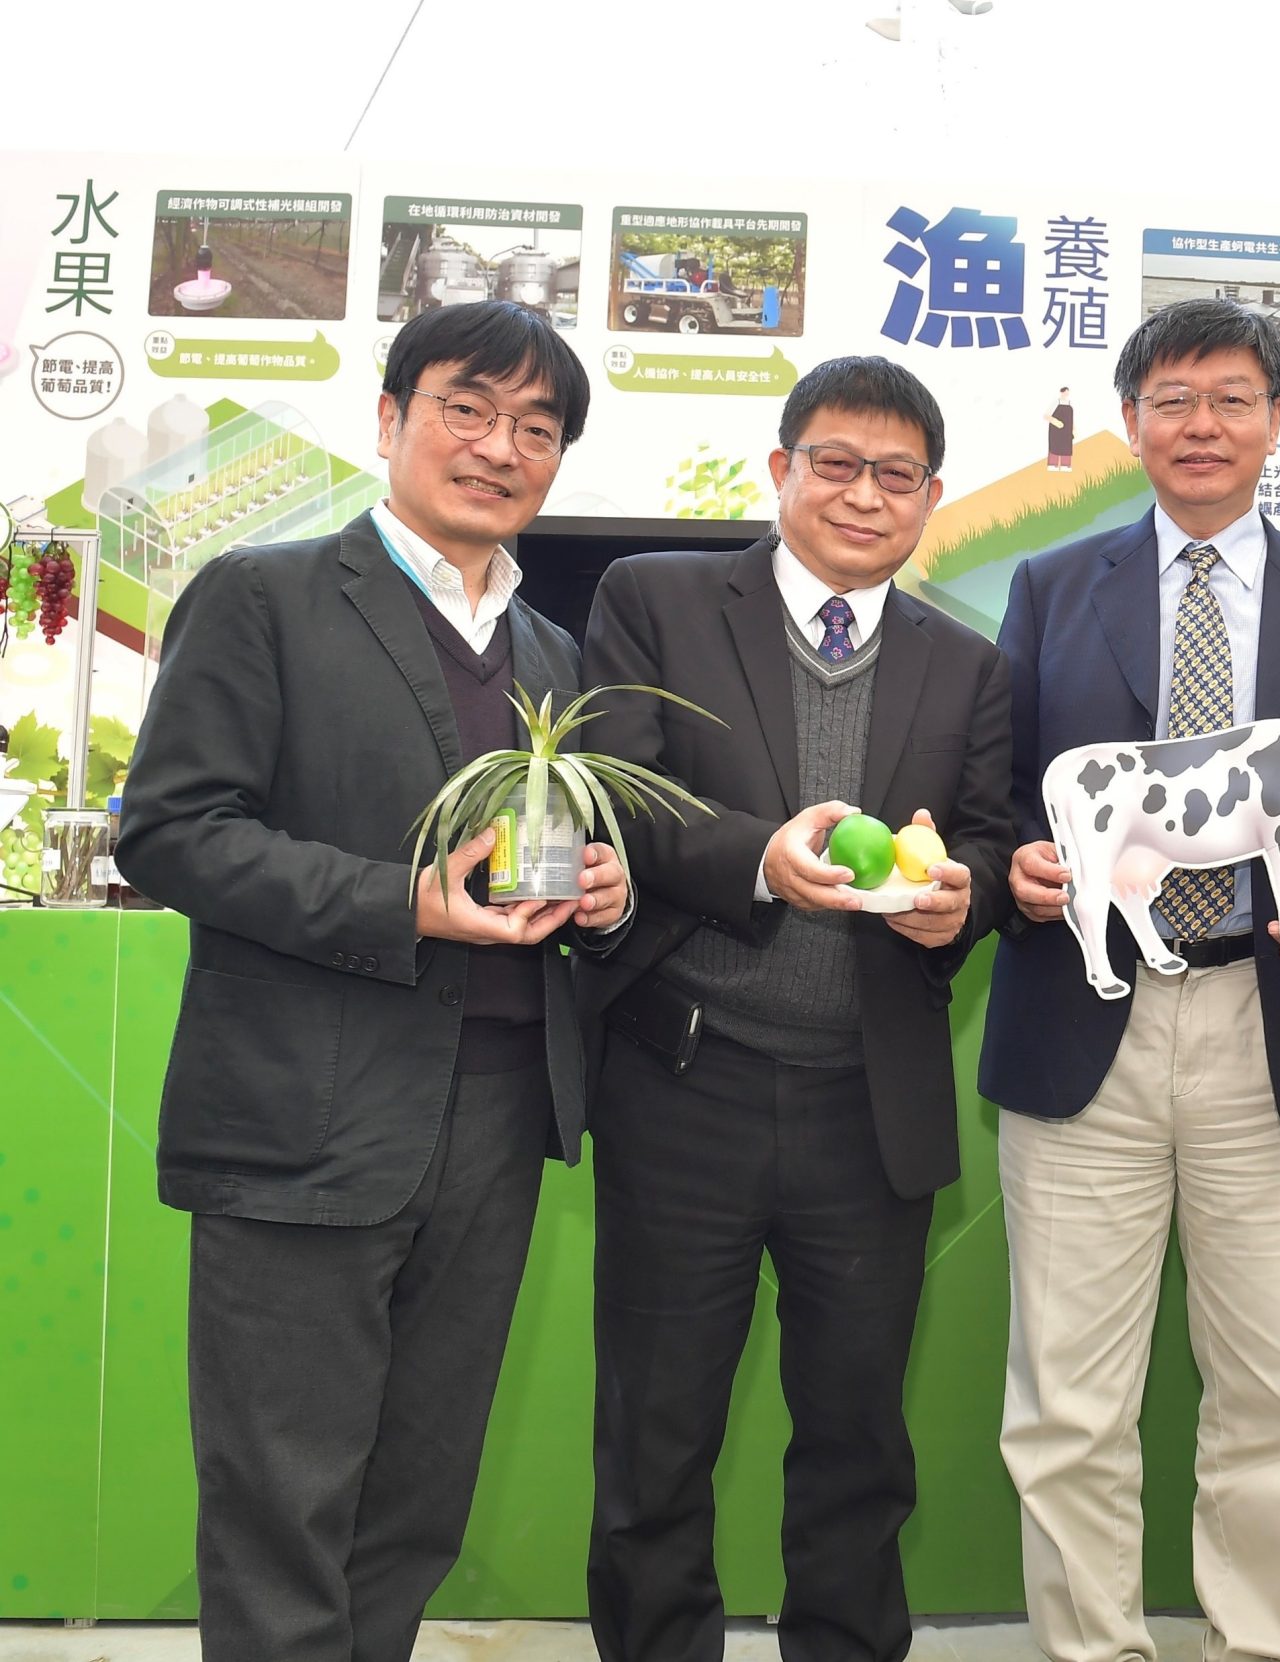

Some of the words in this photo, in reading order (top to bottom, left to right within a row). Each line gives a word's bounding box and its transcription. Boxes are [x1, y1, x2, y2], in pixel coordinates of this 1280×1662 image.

[167, 197, 342, 213] 經濟作物可調式性補光模組開發
[408, 203, 561, 223] 在地循環利用防治資材開發
[620, 213, 802, 232] 重型適應地形協作載具平台先期開發
[45, 179, 119, 317] 水果
[881, 206, 1031, 350] 漁
[1042, 215, 1109, 349] 養殖
[41, 358, 114, 375] 節電、提高
